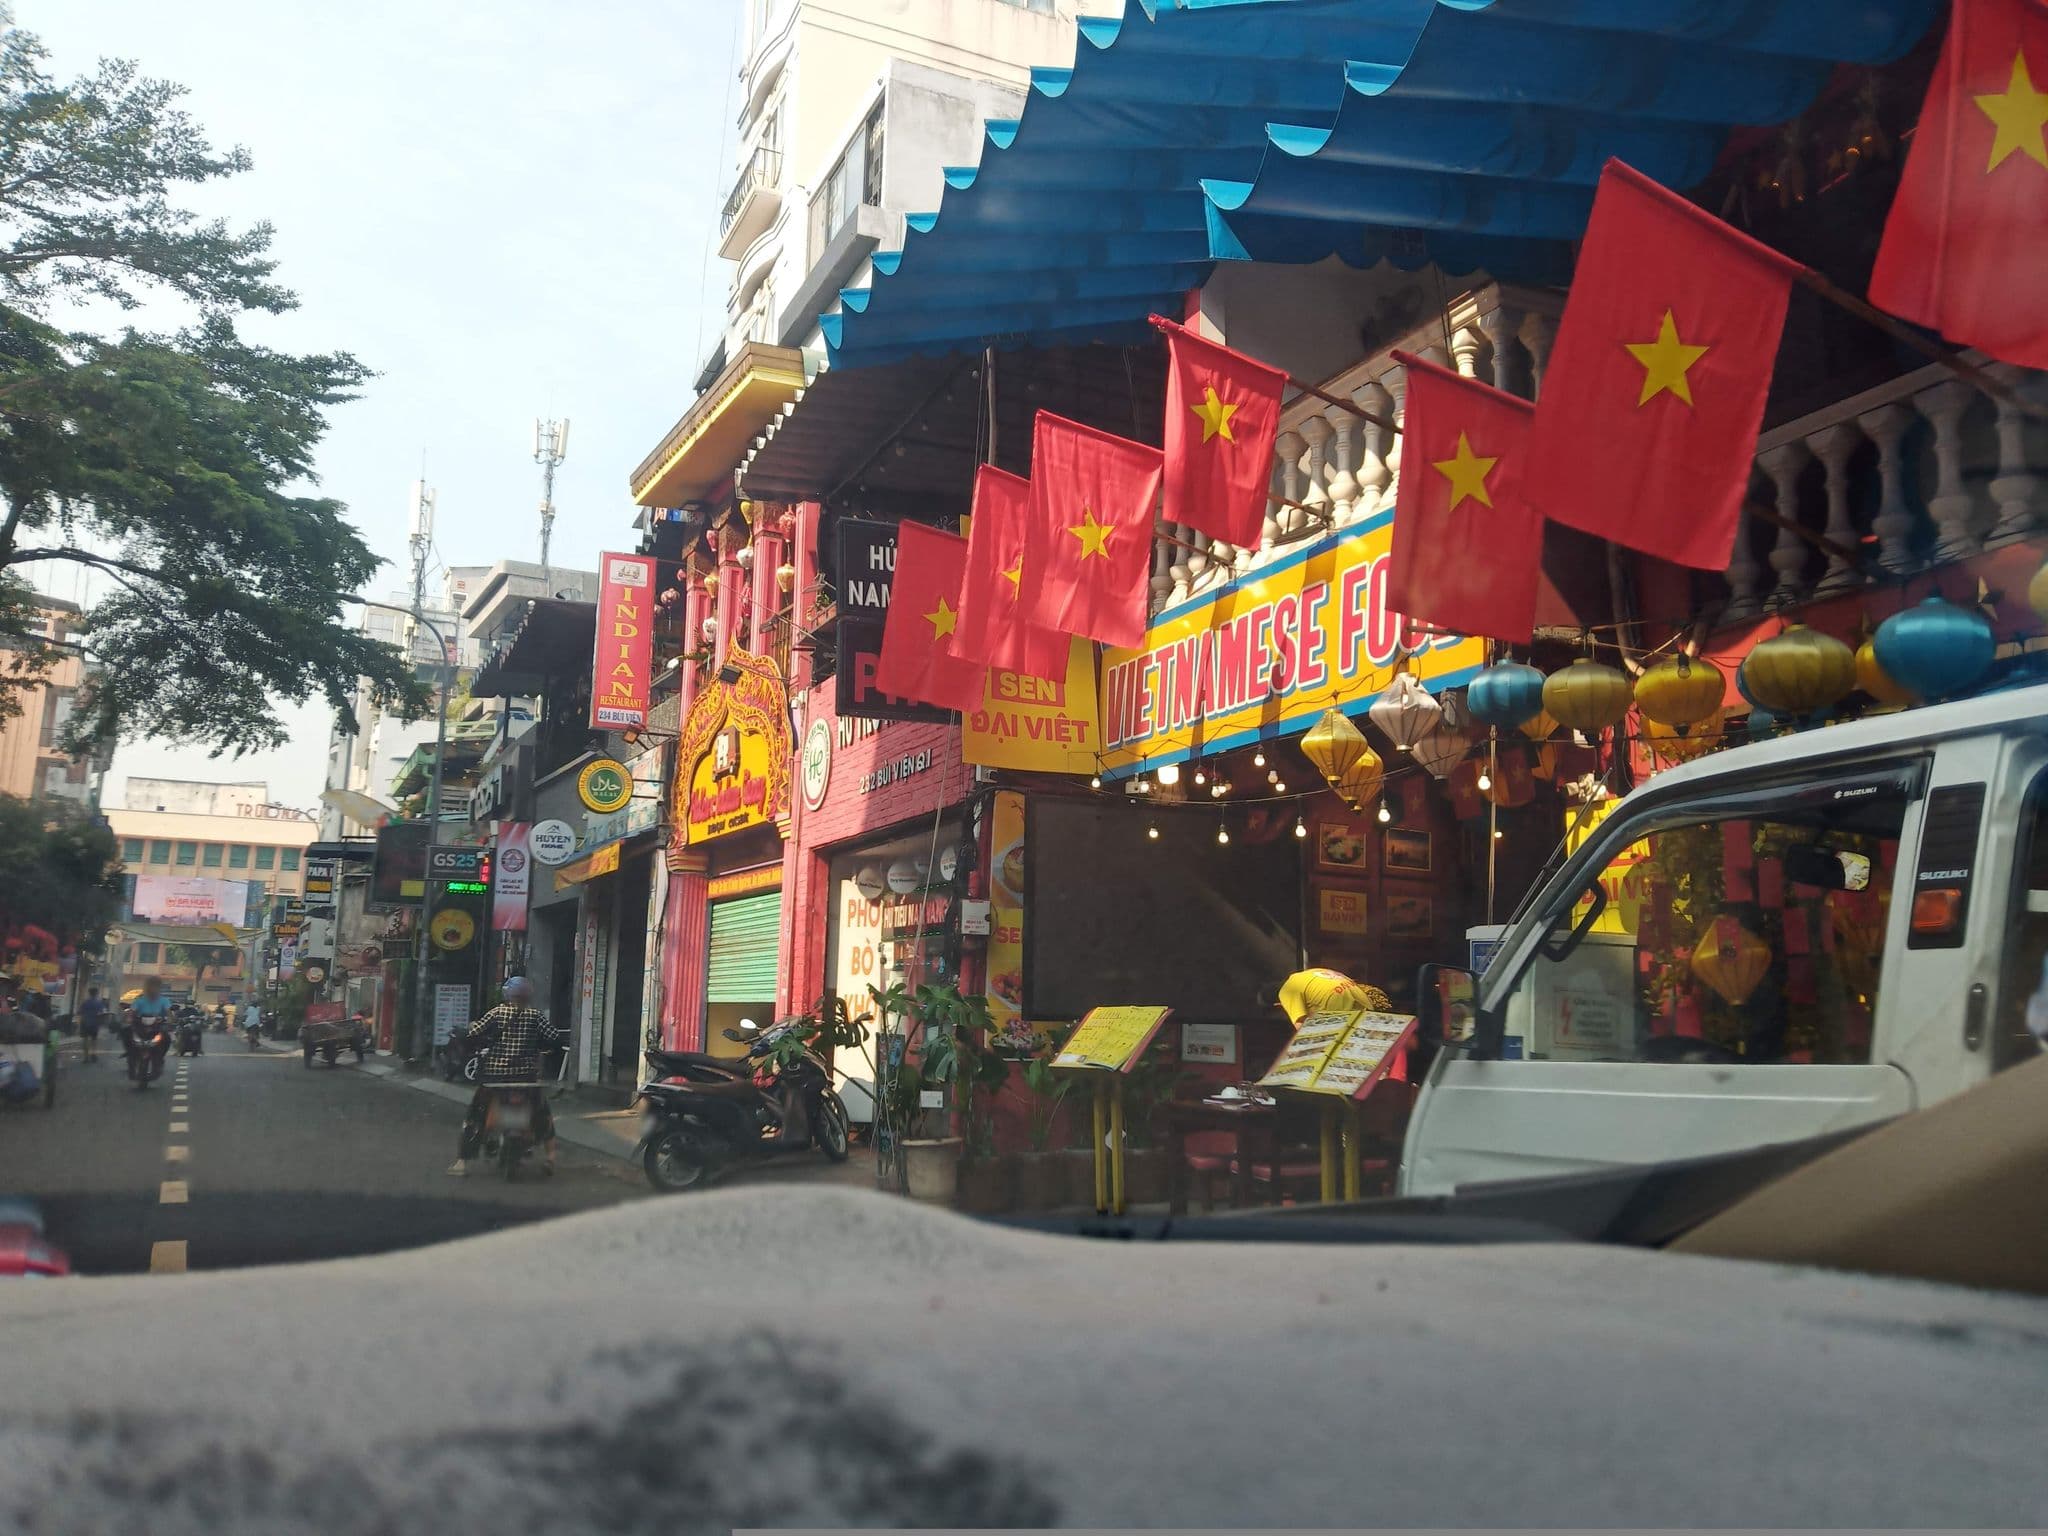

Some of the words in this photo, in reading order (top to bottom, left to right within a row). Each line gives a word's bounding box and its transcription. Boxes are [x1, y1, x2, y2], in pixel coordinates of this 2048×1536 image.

[613, 587, 639, 697] INDIAN
[1106, 580, 1327, 748] VIETNAMESE
[1338, 551, 1455, 675] FO
[600, 695, 643, 708] RESTAURANT
[999, 671, 1057, 702] SEN
[599, 709, 612, 720] 234
[970, 709, 1018, 744] ĐẠI
[1023, 711, 1090, 750] VIỆT
[859, 773, 878, 795] 232
[877, 758, 892, 789] BÙI
[893, 752, 915, 783] VIỆN
[915, 748, 934, 773] Q1
[1843, 786, 1878, 798] SUZUKI
[433, 852, 477, 868] GS25
[1920, 869, 1969, 881] SUZUKI
[851, 937, 874, 976] BÒ
